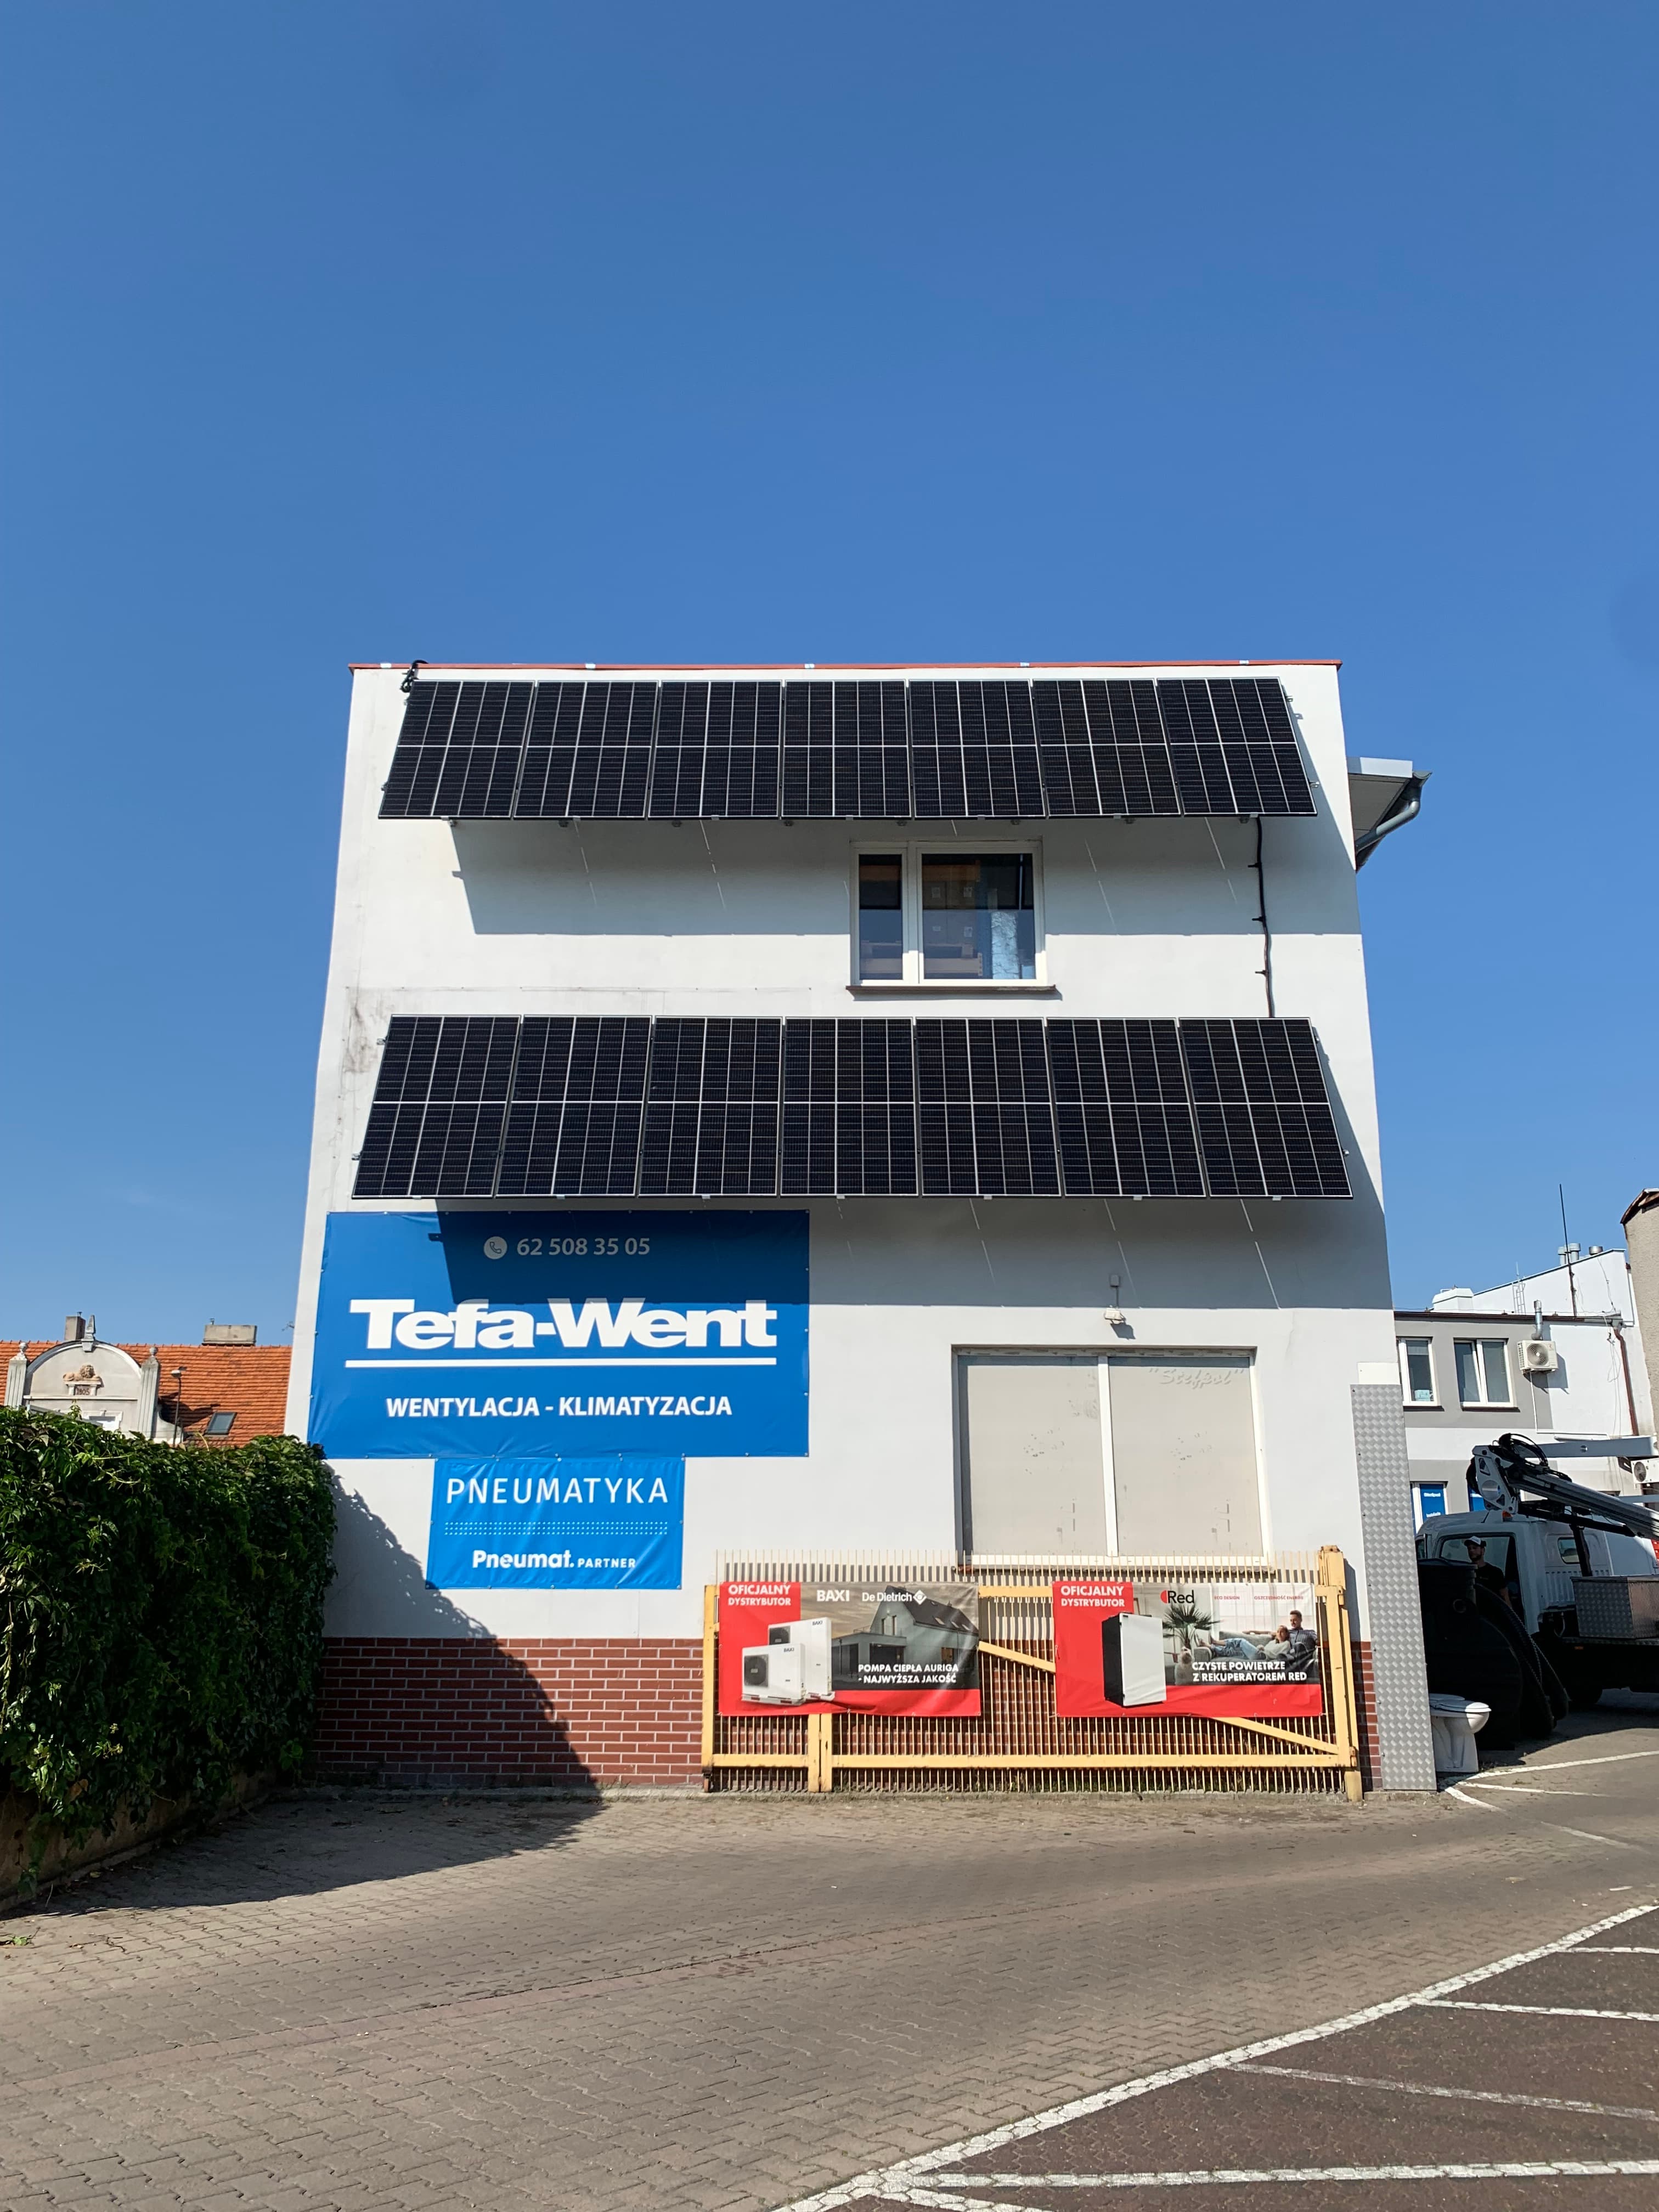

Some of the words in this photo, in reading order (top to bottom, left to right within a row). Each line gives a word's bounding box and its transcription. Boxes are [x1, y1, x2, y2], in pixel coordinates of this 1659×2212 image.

[517, 1238, 542, 1255] 62
[549, 1238, 588, 1255] 508
[594, 1238, 618, 1255] 35
[625, 1238, 650, 1255] 05
[349, 1297, 778, 1349] Tefa-Went
[386, 1396, 540, 1418] WENTYLACJA
[559, 1396, 732, 1417] KLIMATYZACJA
[447, 1477, 668, 1504] PNEUMATYKA
[472, 1550, 574, 1568] Pneumat.
[578, 1558, 636, 1568] PARTNER
[728, 1584, 791, 1595] OFICJALNY
[817, 1589, 850, 1601] BAXI
[1060, 1585, 1124, 1596] OFICJALNY
[728, 1597, 791, 1606] DYSTRYBUTOR
[862, 1592, 876, 1602] De
[877, 1590, 912, 1602] Dietrich
[1167, 1590, 1195, 1604] Red
[1061, 1598, 1125, 1607] DYSTRYBUTOR
[858, 1664, 891, 1672] POMPA
[893, 1663, 922, 1672] CIEPŁA
[924, 1663, 959, 1672] AURIGA
[1192, 1662, 1227, 1671] CZYSTE
[1228, 1661, 1285, 1671] POWIETRZE
[864, 1673, 920, 1684] NAJWYŻSZA
[921, 1672, 956, 1684] JAKOŚĆ
[1193, 1673, 1200, 1681] Z
[1201, 1672, 1286, 1681] REKUPERATOREM
[1288, 1672, 1307, 1680] RED
